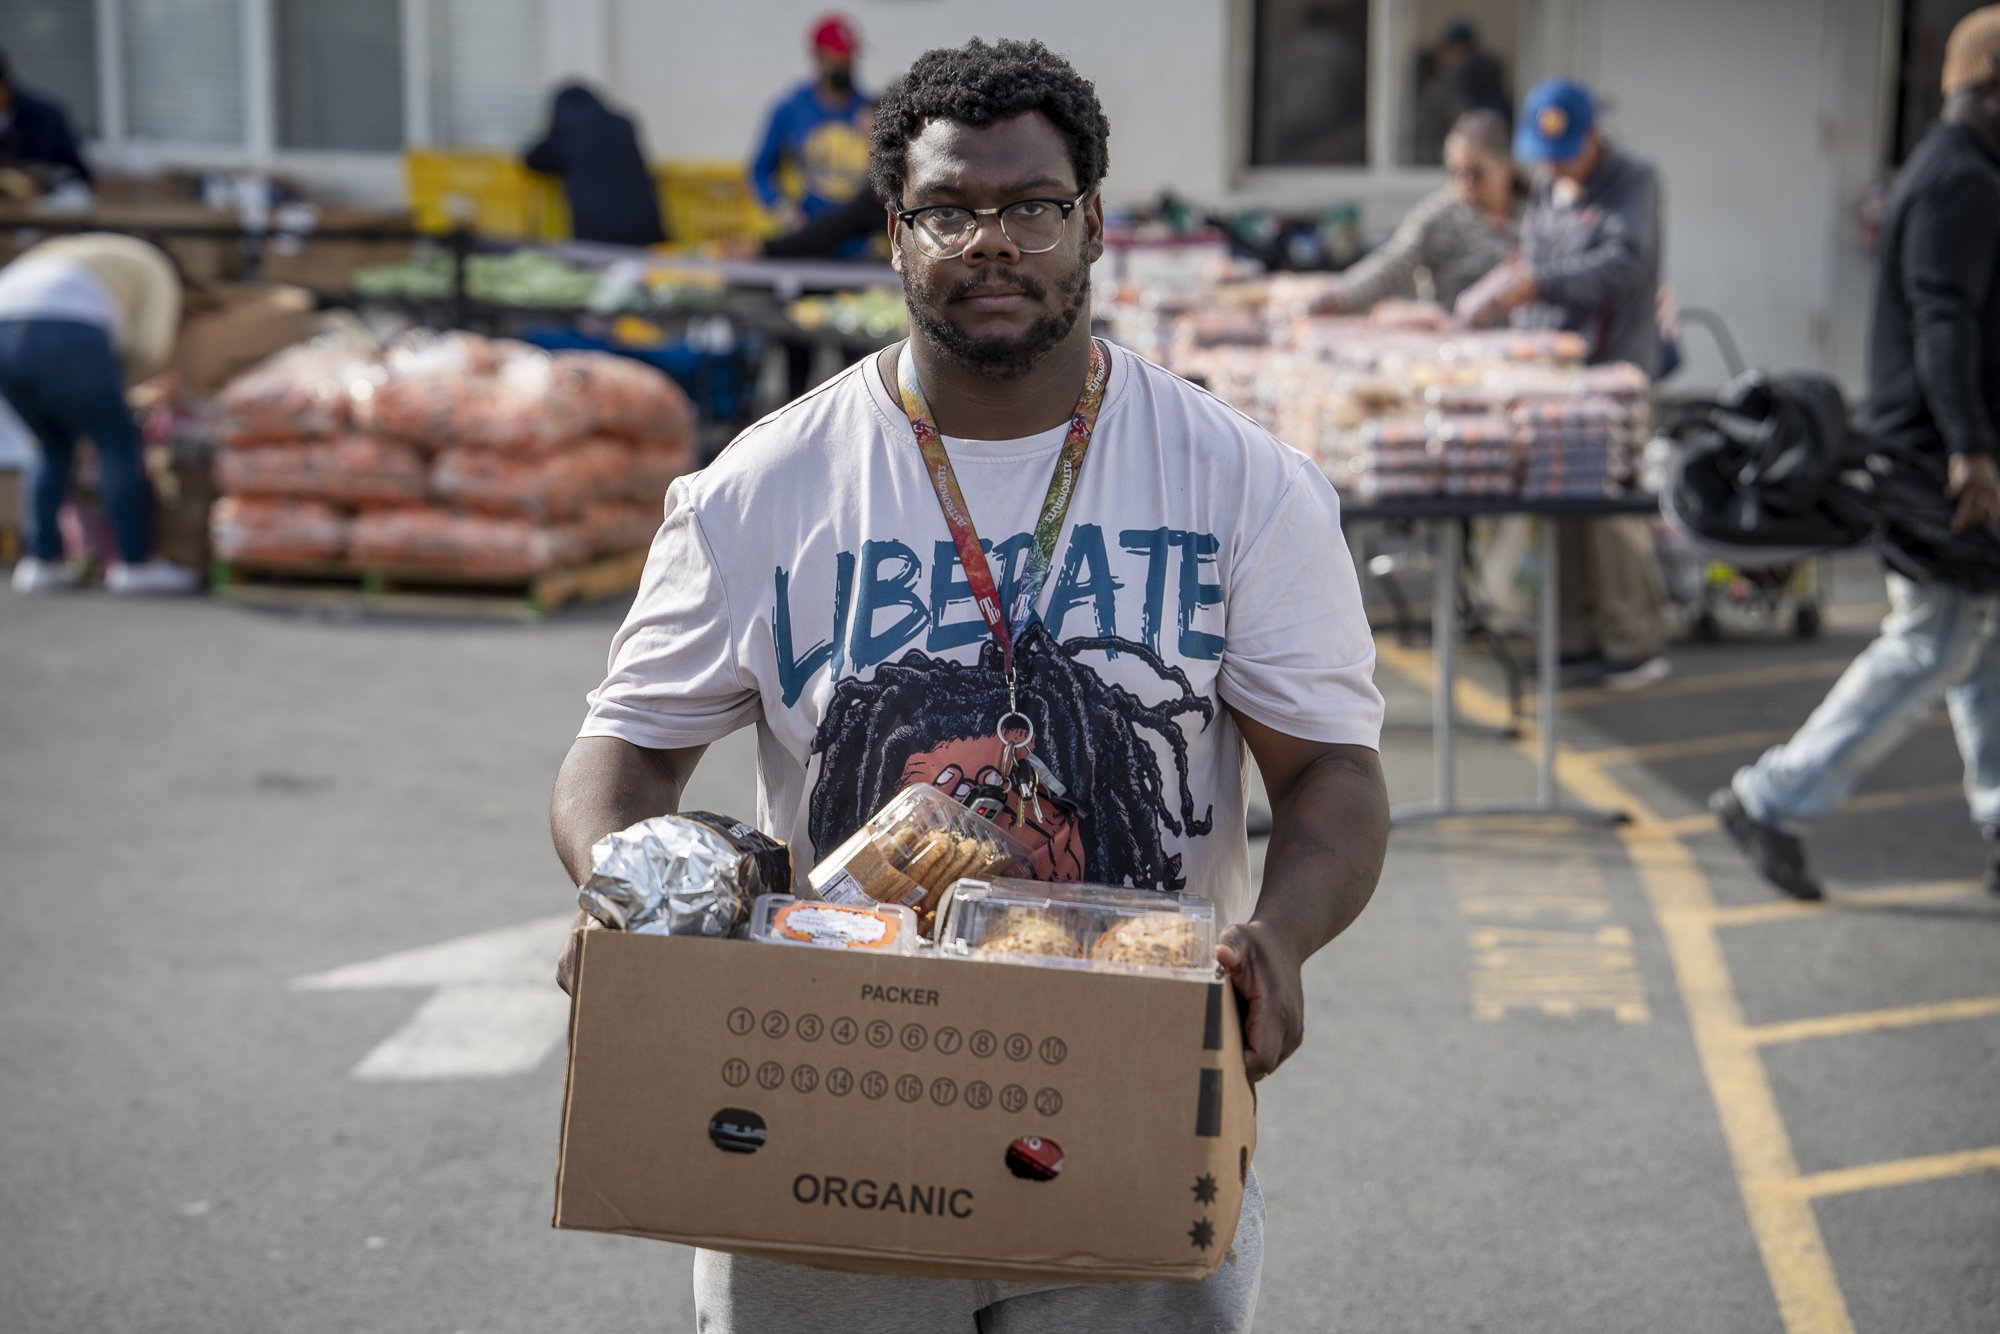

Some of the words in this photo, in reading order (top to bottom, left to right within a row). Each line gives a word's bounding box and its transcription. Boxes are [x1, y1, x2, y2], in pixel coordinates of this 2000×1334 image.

[937, 463, 968, 528] ASTRONAUTS
[1044, 459, 1072, 524] ASTRONAUTS
[861, 984, 940, 1007] PACKER
[792, 1173, 974, 1219] ORGANIC
